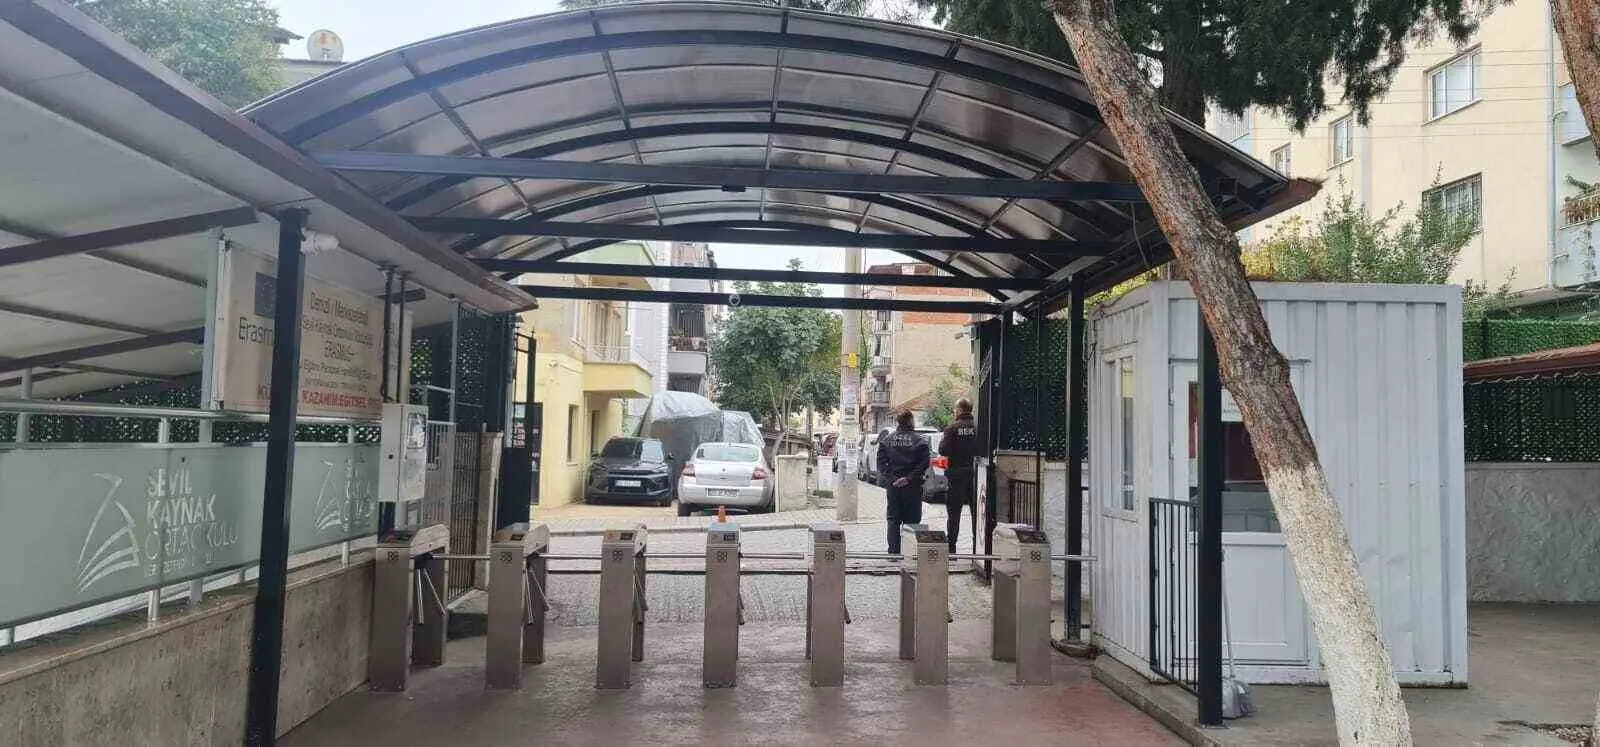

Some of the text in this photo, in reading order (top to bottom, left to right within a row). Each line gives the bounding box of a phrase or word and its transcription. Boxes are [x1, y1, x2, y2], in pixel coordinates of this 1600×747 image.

[239, 316, 274, 346] Erasm
[958, 427, 976, 436] BEK
[146, 493, 217, 530] KAYNAK
